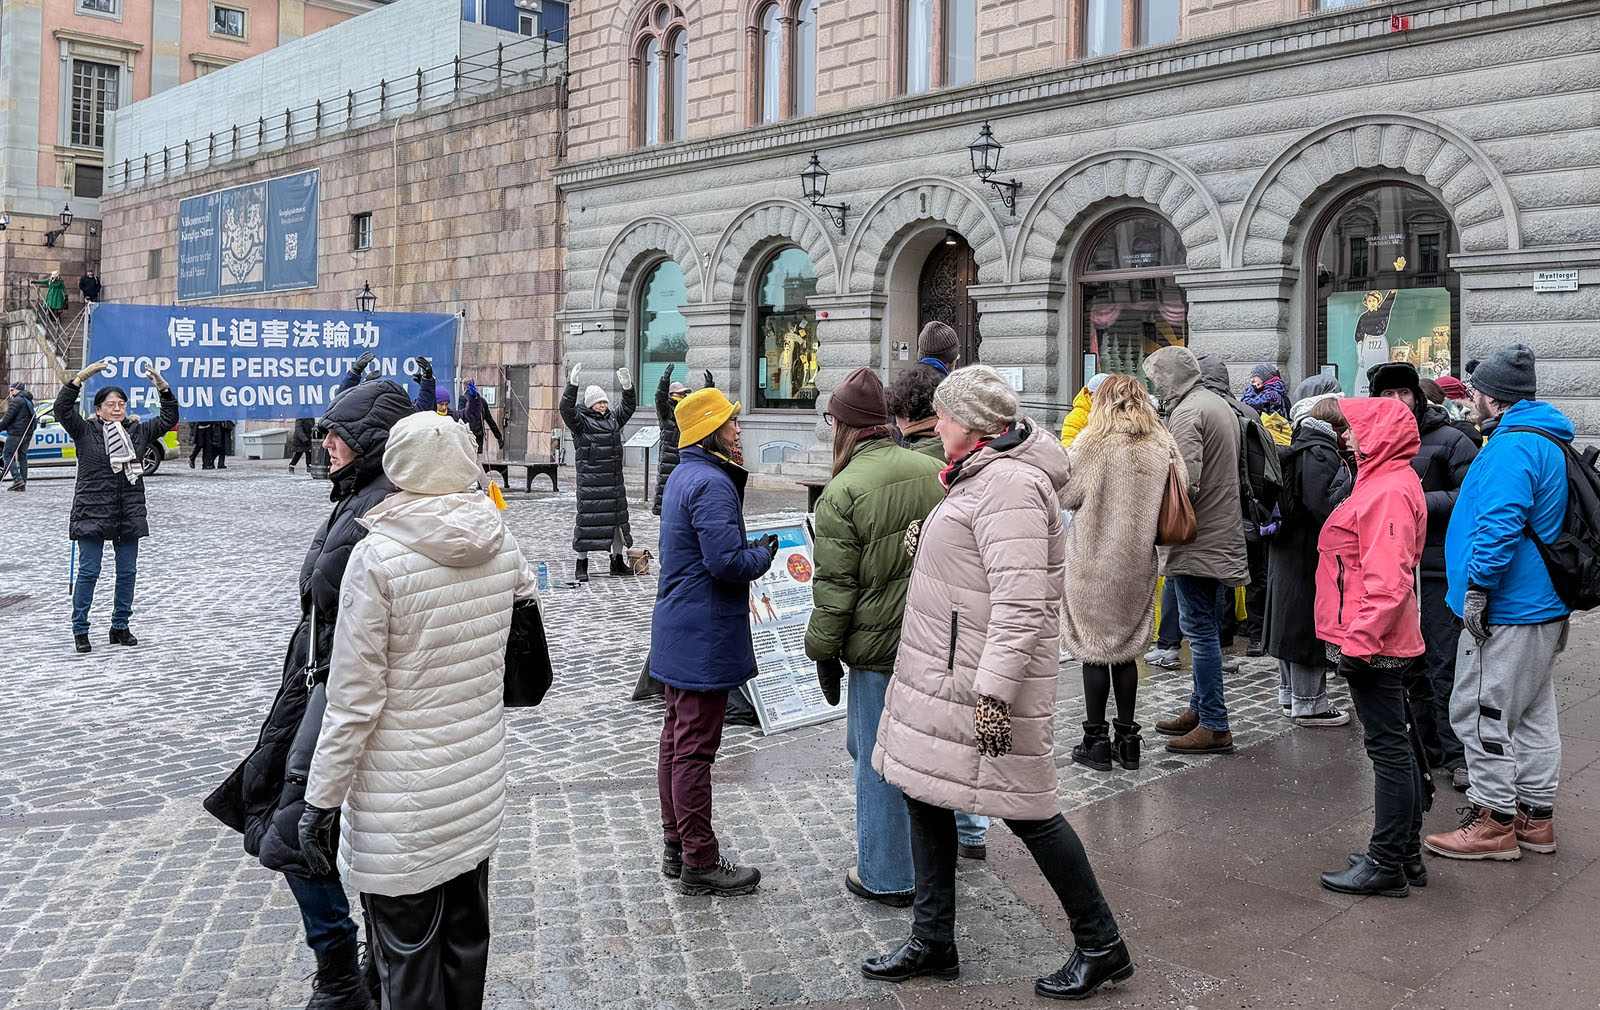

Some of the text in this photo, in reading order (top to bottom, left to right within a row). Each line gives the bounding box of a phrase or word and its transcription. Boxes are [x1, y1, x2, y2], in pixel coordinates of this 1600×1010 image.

[168, 317, 380, 348] 停止迫害法輪功
[101, 356, 171, 378] STOP
[178, 357, 226, 378] THE
[232, 357, 397, 377] PERSECUTON
[130, 386, 213, 408] FAUN
[220, 385, 292, 407] GONG
[296, 384, 323, 405] IN
[35, 433, 74, 445] POLI
